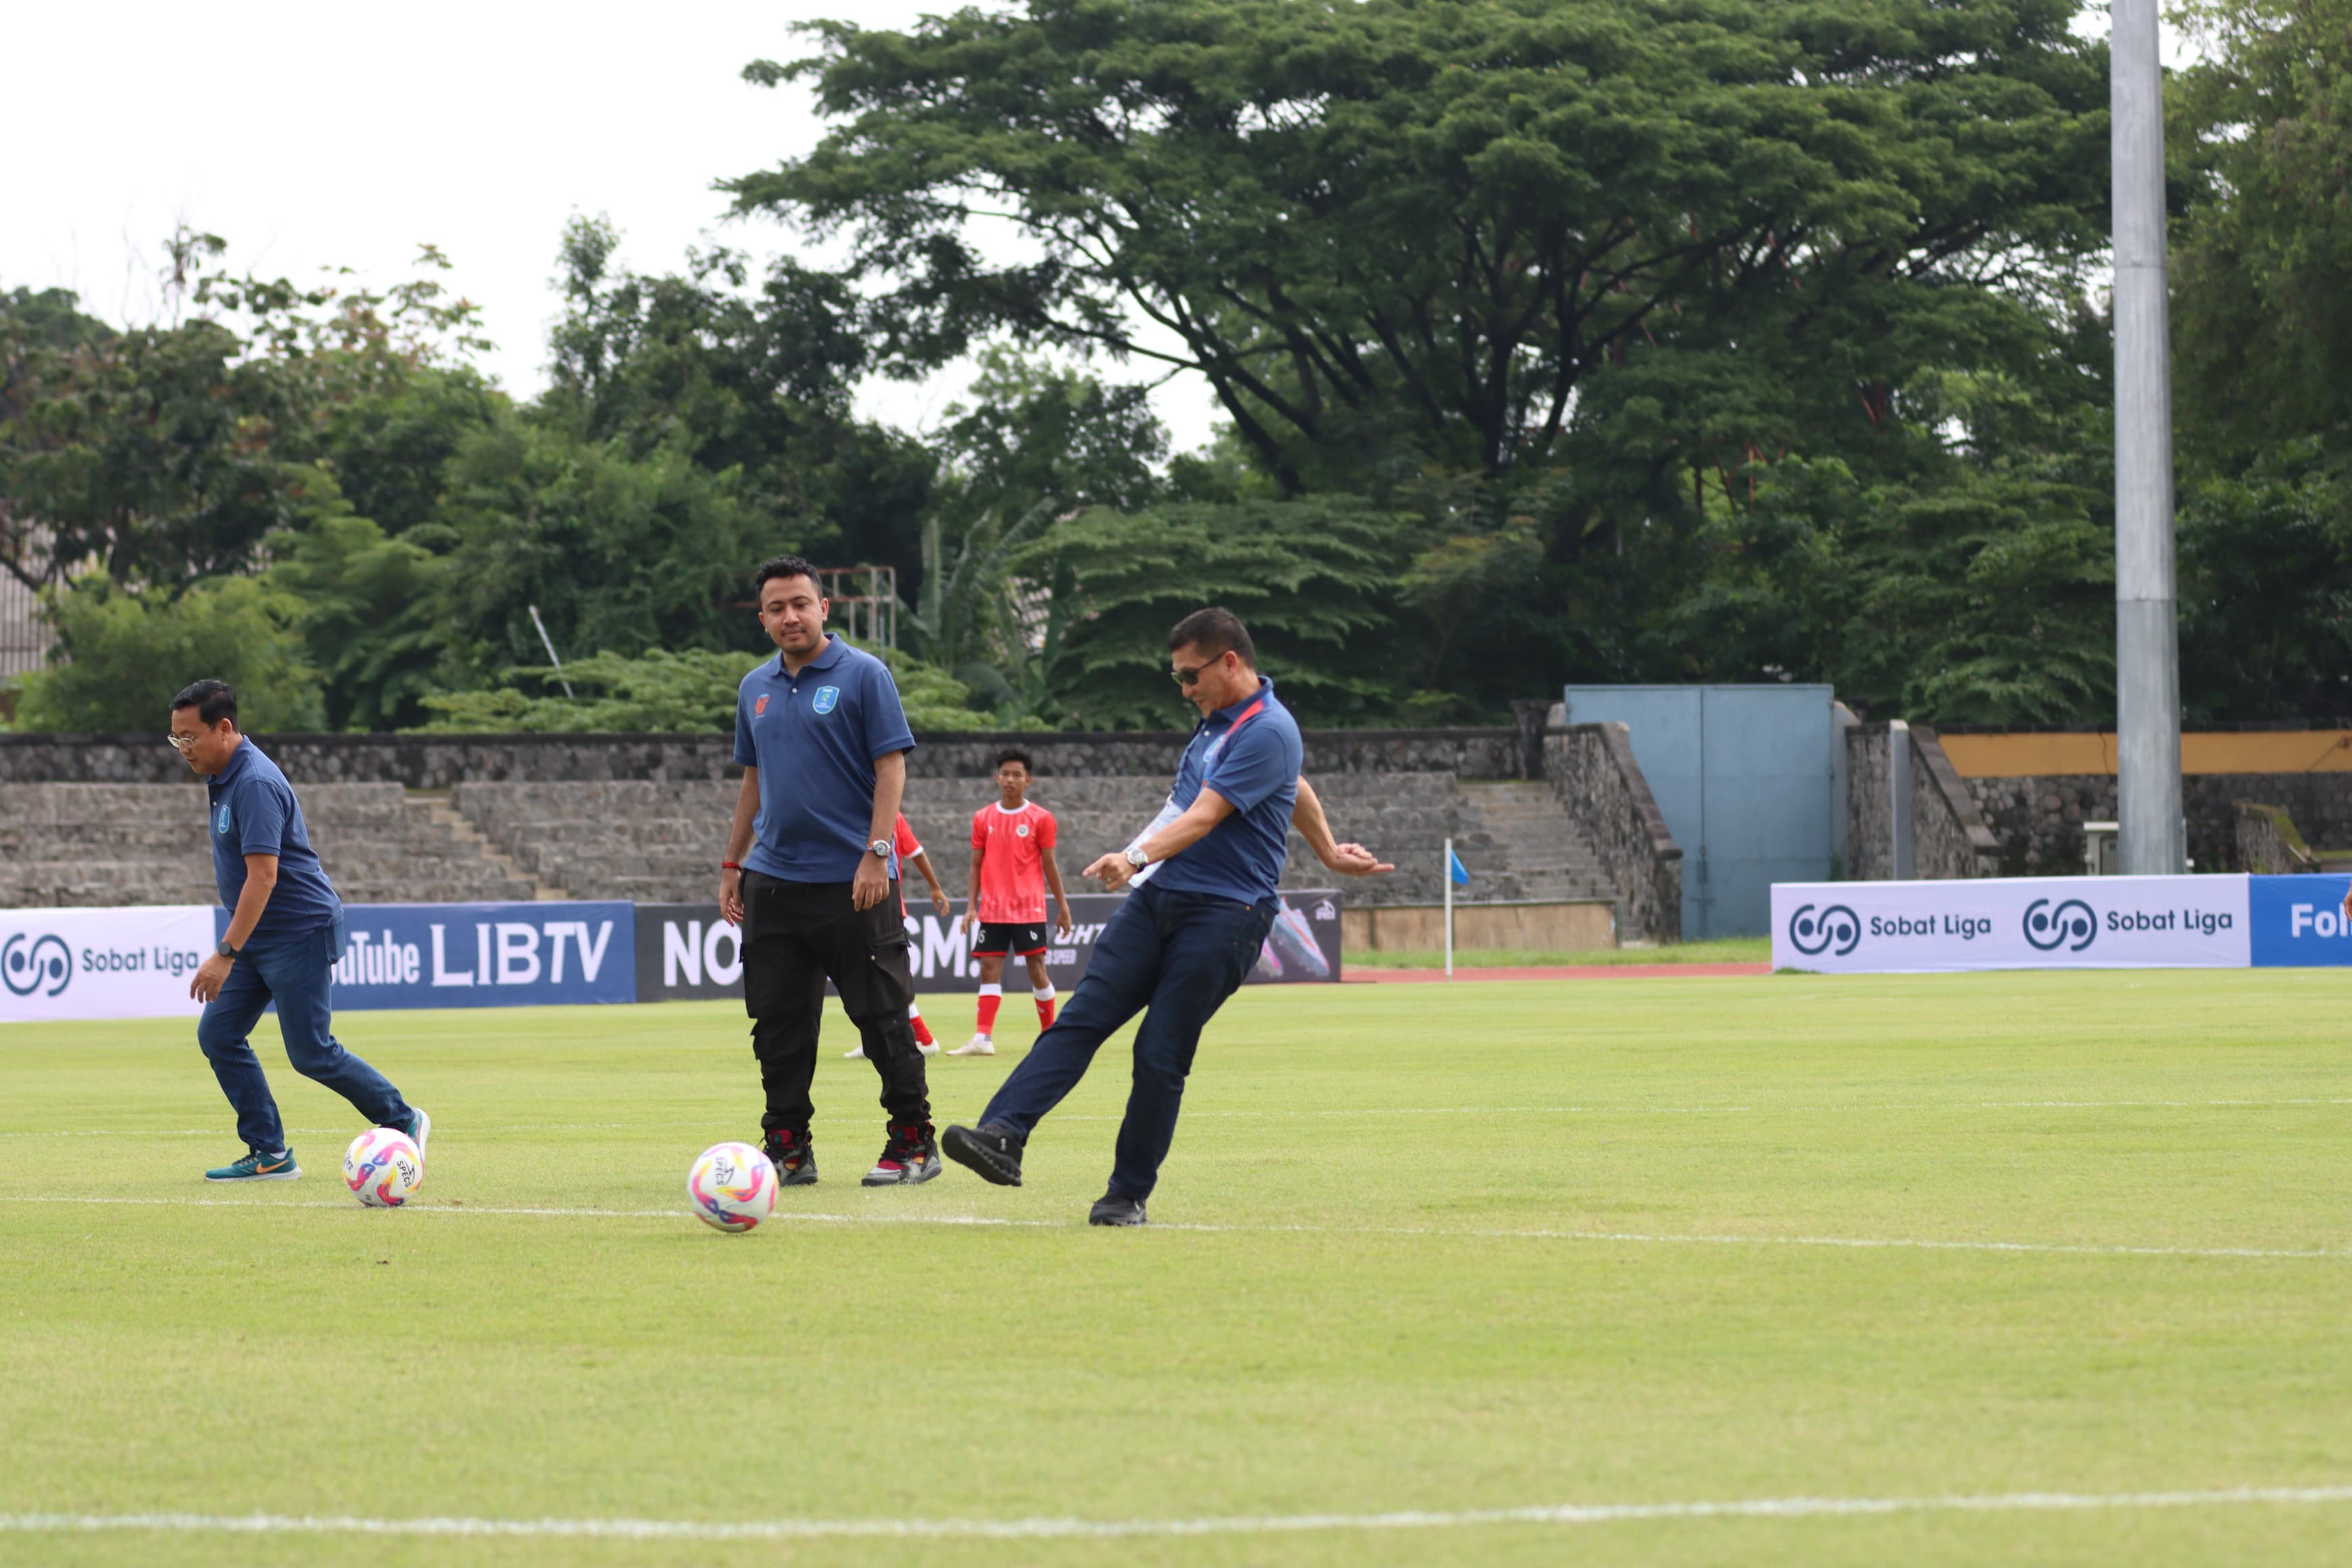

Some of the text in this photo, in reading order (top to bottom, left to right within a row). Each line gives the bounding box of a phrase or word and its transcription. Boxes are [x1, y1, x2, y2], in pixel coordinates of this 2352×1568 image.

[1870, 914, 1992, 940] Sobat Liga
[2107, 909, 2233, 935] Sobat Liga
[2291, 902, 2352, 938] Fol
[82, 946, 199, 977] Sobat Liga
[331, 921, 614, 987] uTube LIBTV
[397, 1160, 412, 1188] SPECS
